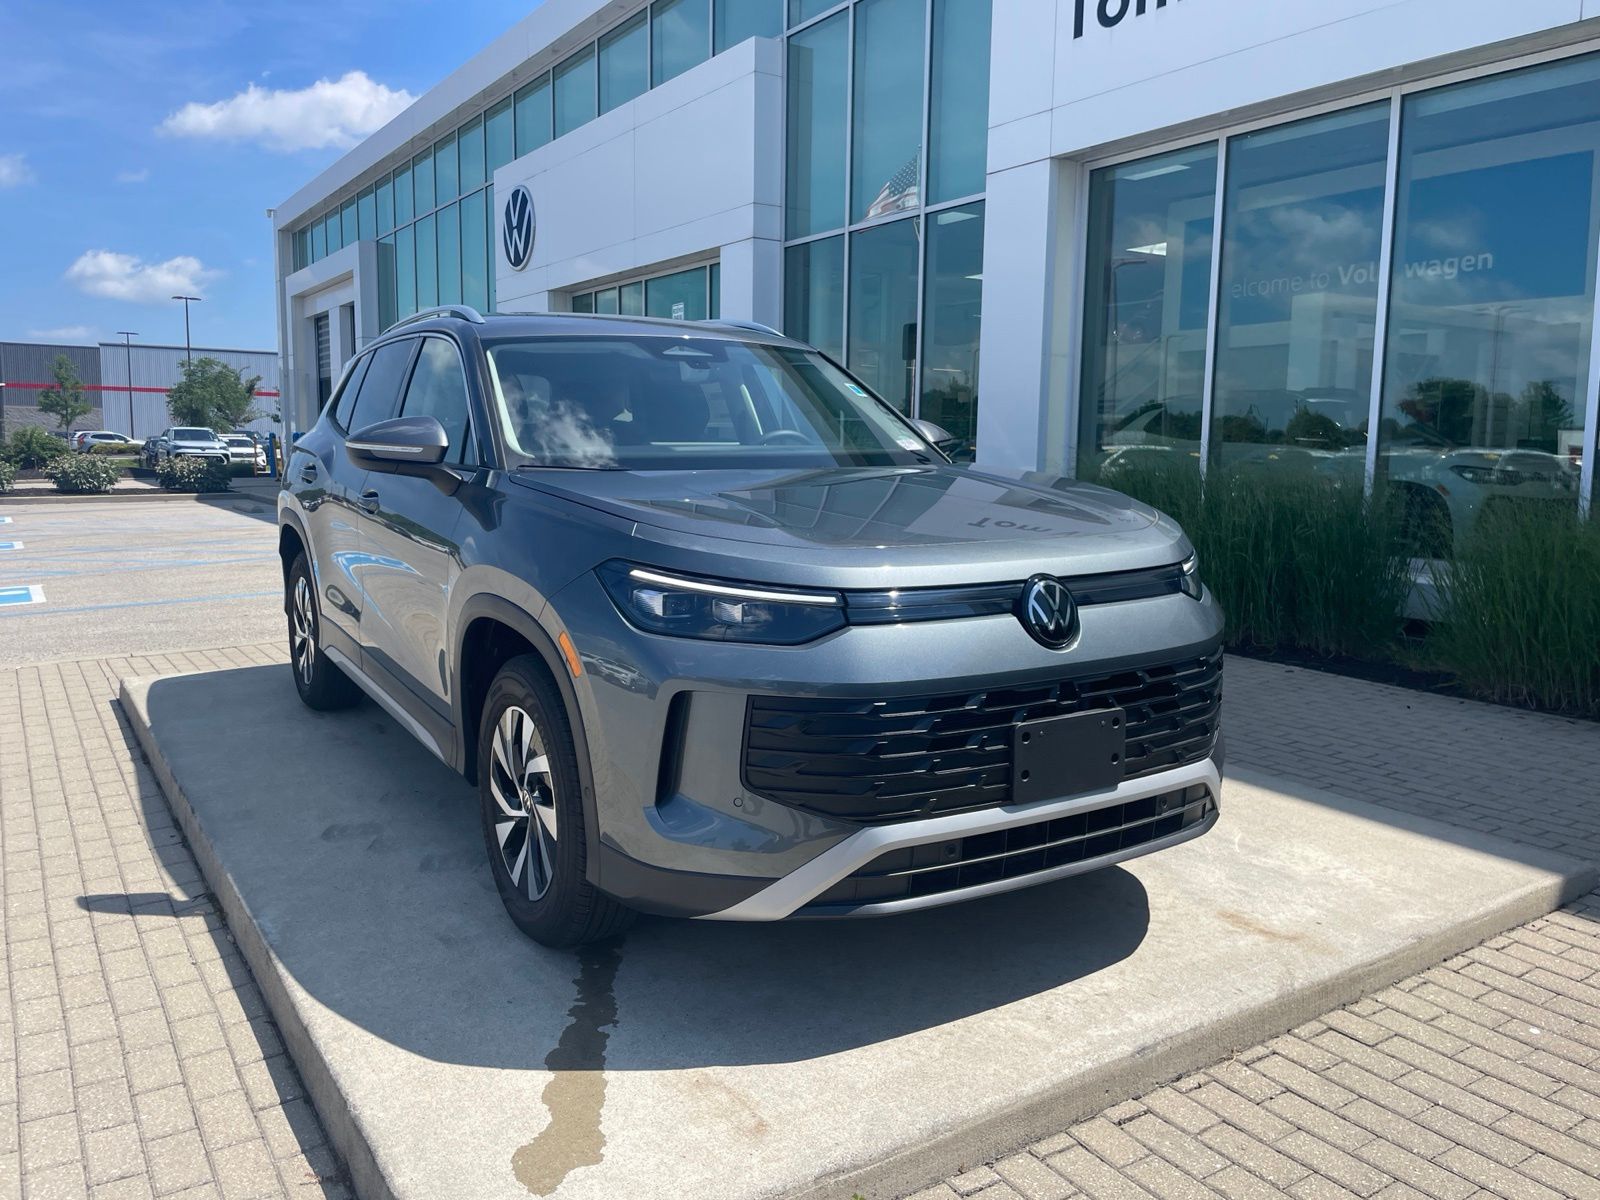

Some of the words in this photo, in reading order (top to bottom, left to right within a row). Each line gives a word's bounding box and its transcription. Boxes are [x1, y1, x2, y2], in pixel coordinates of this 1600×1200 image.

[1072, 0, 1183, 40] To
[1231, 275, 1303, 298] elcome
[1311, 272, 1330, 289] to
[1337, 252, 1493, 286] Volwagen
